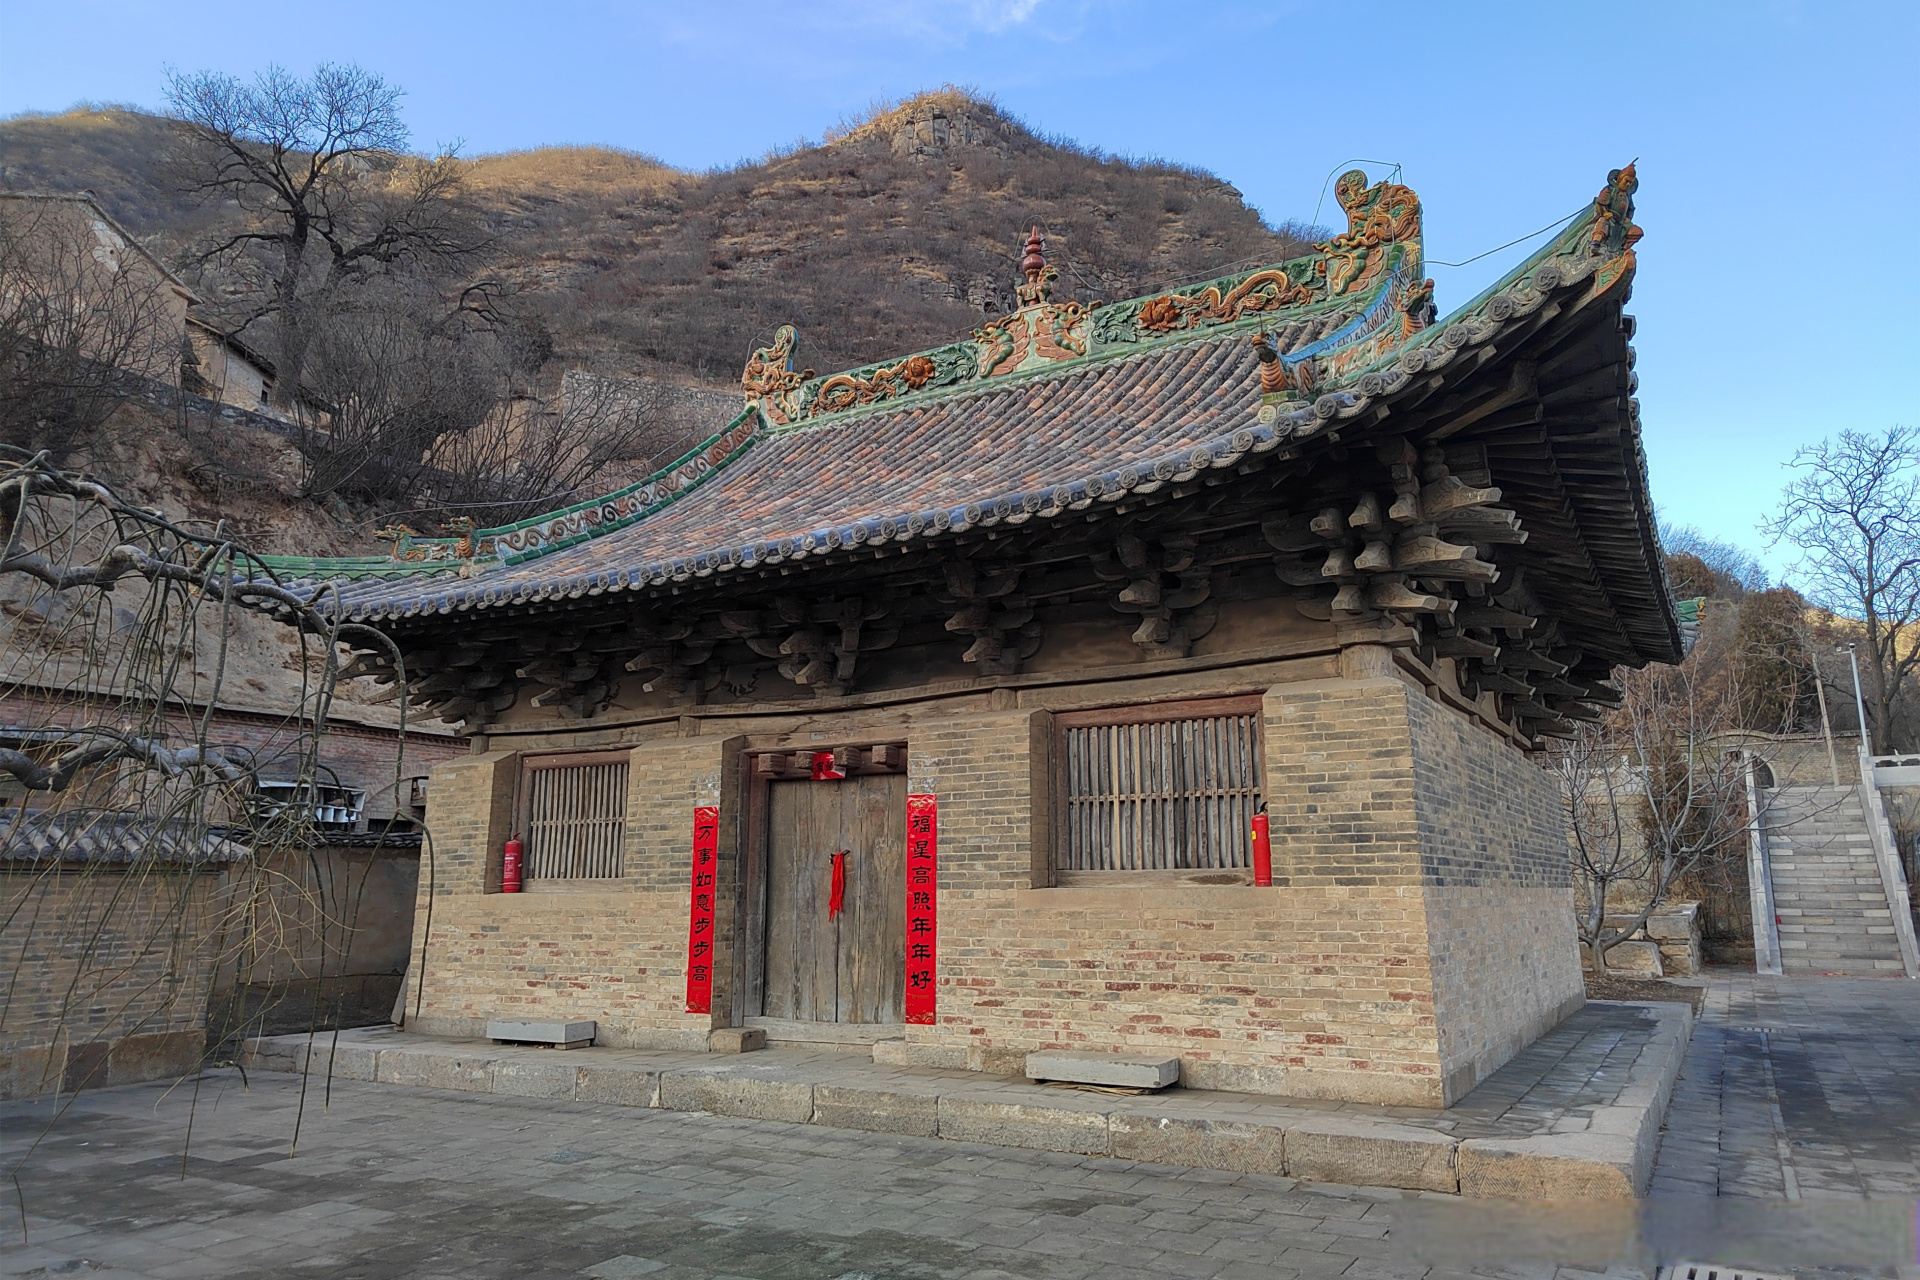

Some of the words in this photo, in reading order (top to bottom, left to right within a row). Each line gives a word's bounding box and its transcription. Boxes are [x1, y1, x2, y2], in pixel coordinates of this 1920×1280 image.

[692, 825, 714, 981] 万事如意步步高
[911, 815, 932, 990] 福星高照年年好
